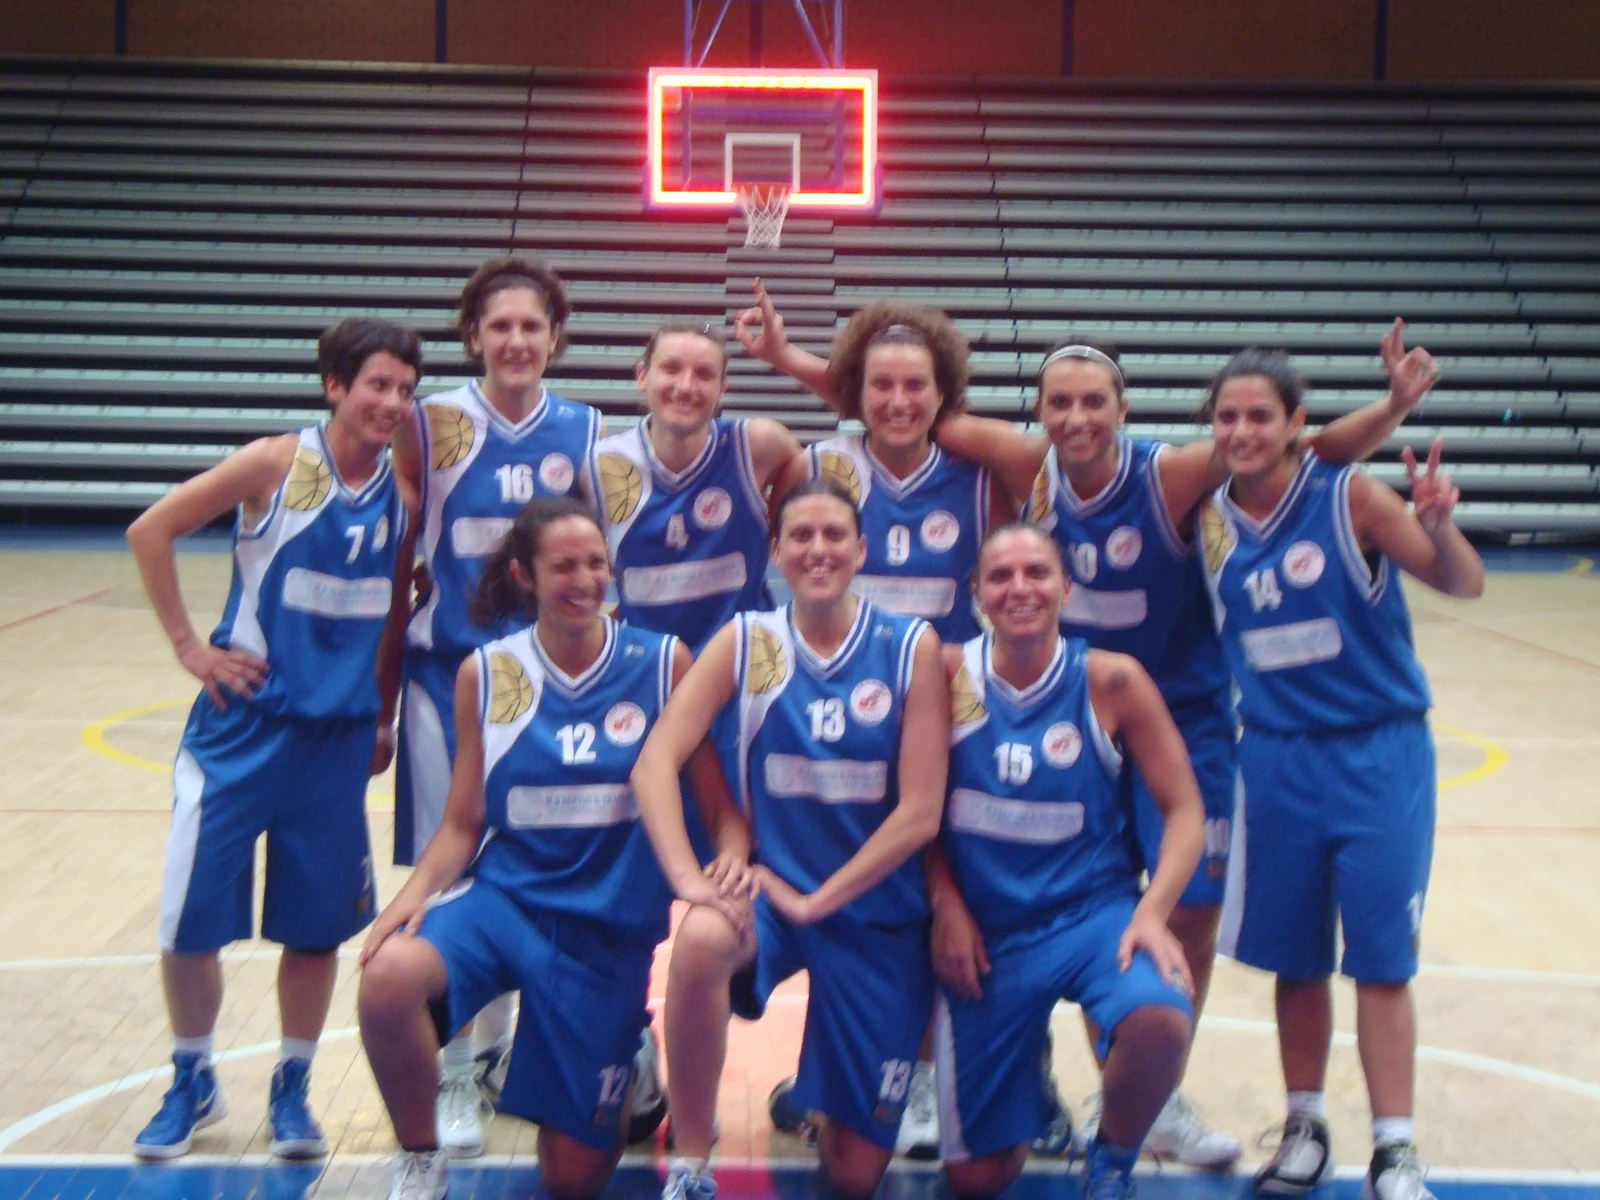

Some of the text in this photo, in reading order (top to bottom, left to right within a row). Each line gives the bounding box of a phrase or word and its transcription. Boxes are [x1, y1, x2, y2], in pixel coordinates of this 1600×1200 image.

[495, 463, 534, 503] 16
[345, 525, 365, 564] 7
[666, 513, 689, 549] 4
[886, 525, 910, 566] 9
[1243, 568, 1282, 612] 14
[806, 698, 846, 743] 13
[555, 722, 596, 765] 12
[993, 742, 1033, 786] 15
[1405, 890, 1424, 935] 1
[597, 1064, 628, 1105] 12
[880, 1058, 912, 1102] 13
